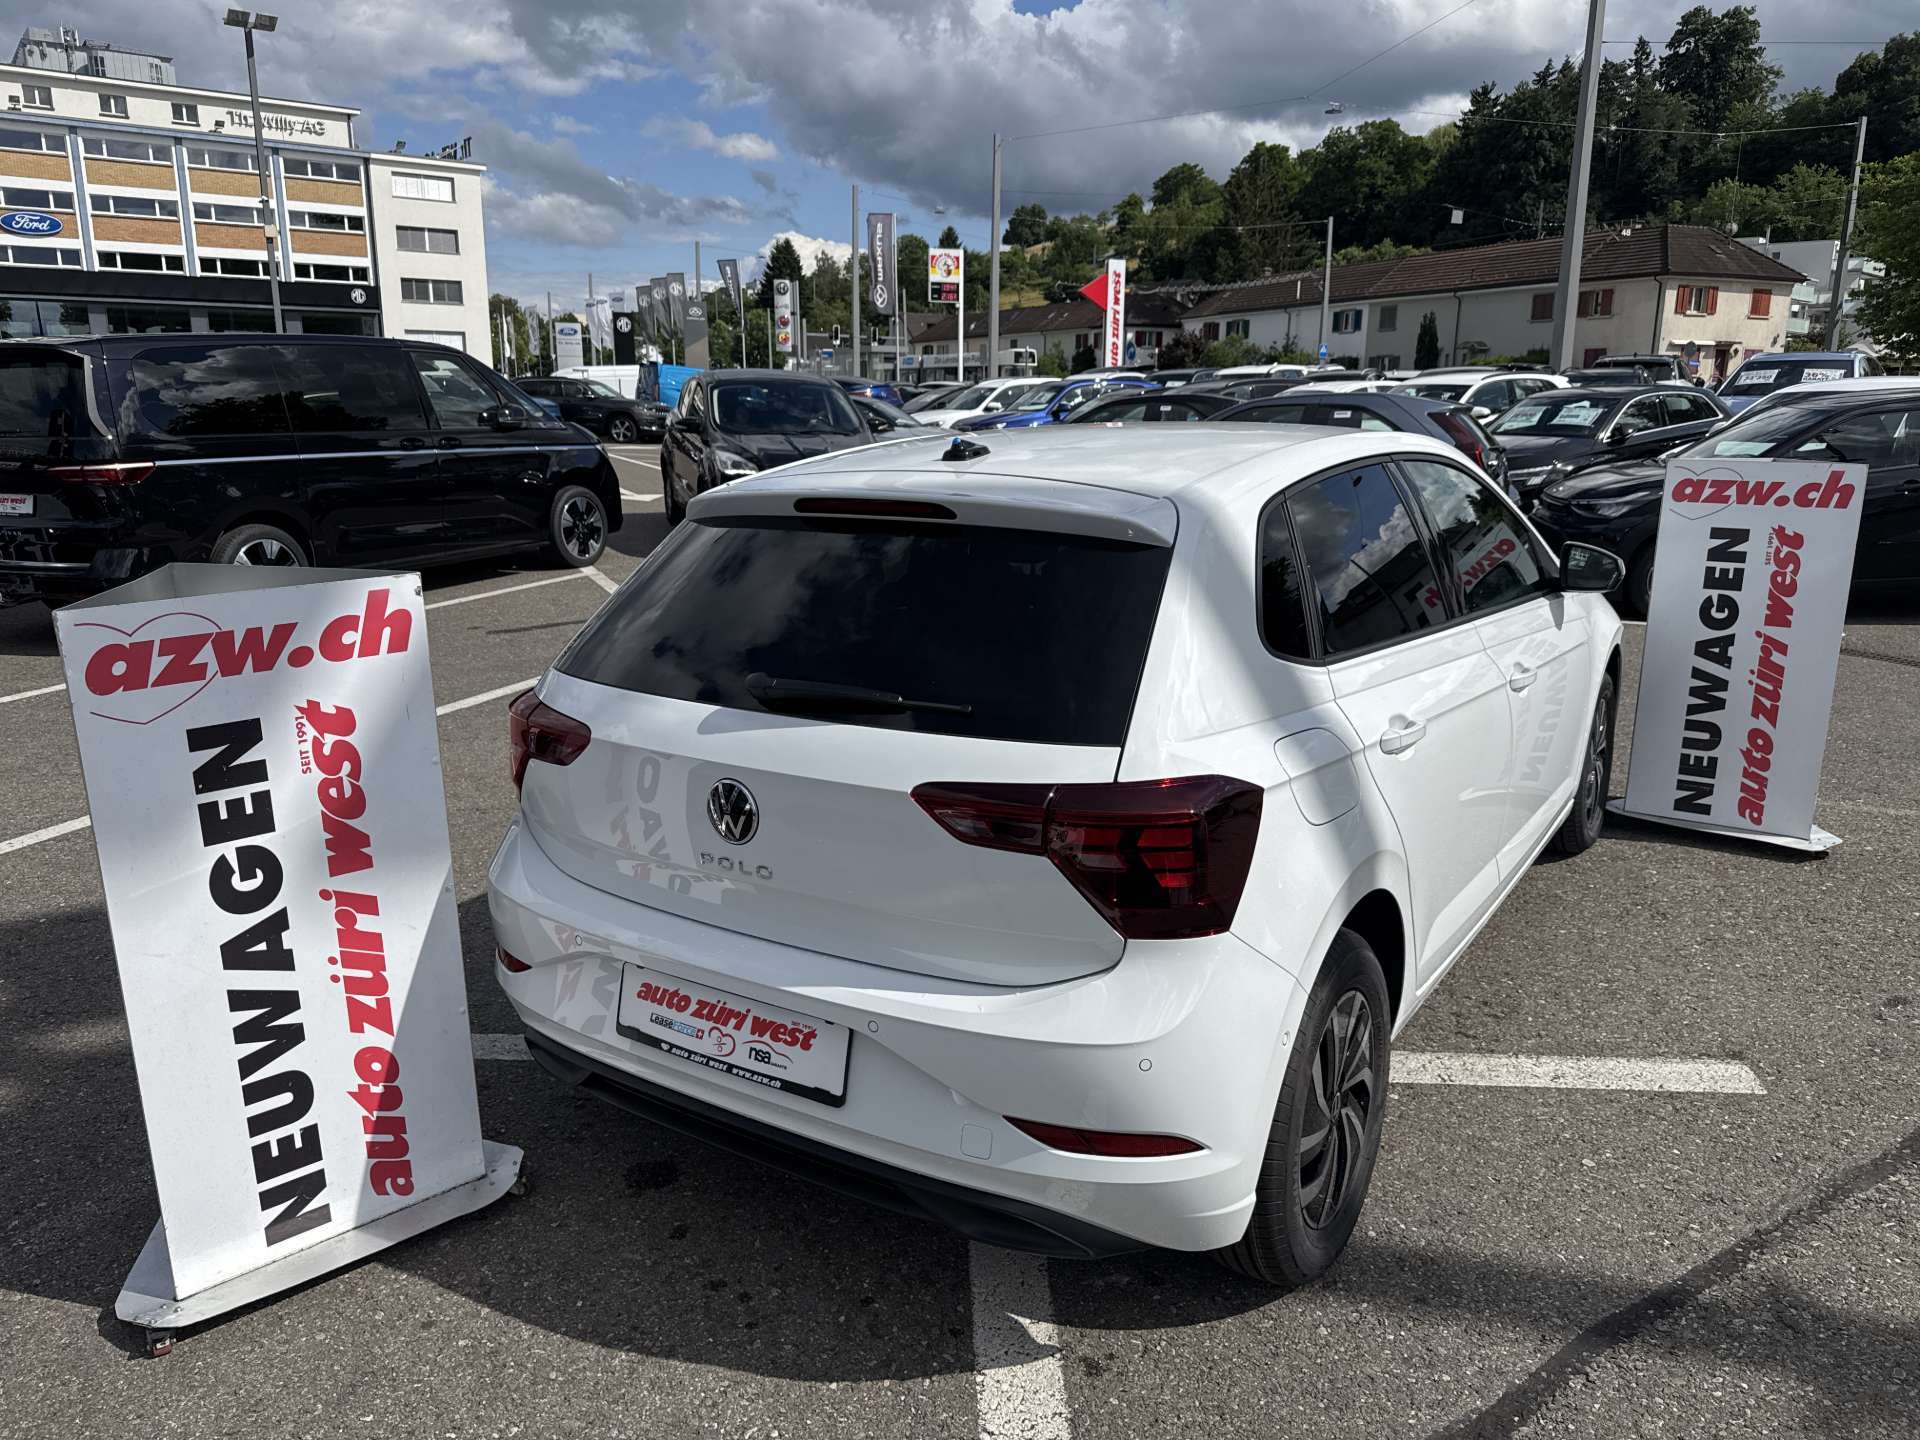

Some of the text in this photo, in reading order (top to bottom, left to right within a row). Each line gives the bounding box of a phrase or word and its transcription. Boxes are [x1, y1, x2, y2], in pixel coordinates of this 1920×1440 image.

[12, 214, 50, 231] Ford
[1111, 342, 1119, 369] uto
[1672, 471, 1855, 509] azw.ch
[85, 588, 412, 697] azw.ch
[1674, 527, 1751, 815] NEUWAGEN
[1738, 524, 1804, 826] auto züri west
[294, 715, 312, 775] SEIT 1991
[700, 852, 774, 880] POLO
[293, 698, 414, 1197] auto züri west
[186, 717, 331, 1246] NEUWAGEN
[636, 981, 818, 1052] auto züri west
[671, 1046, 689, 1058] auto
[708, 1060, 728, 1072] west
[731, 1067, 782, 1088] www.azw.ch
[748, 1046, 772, 1065] nsa
